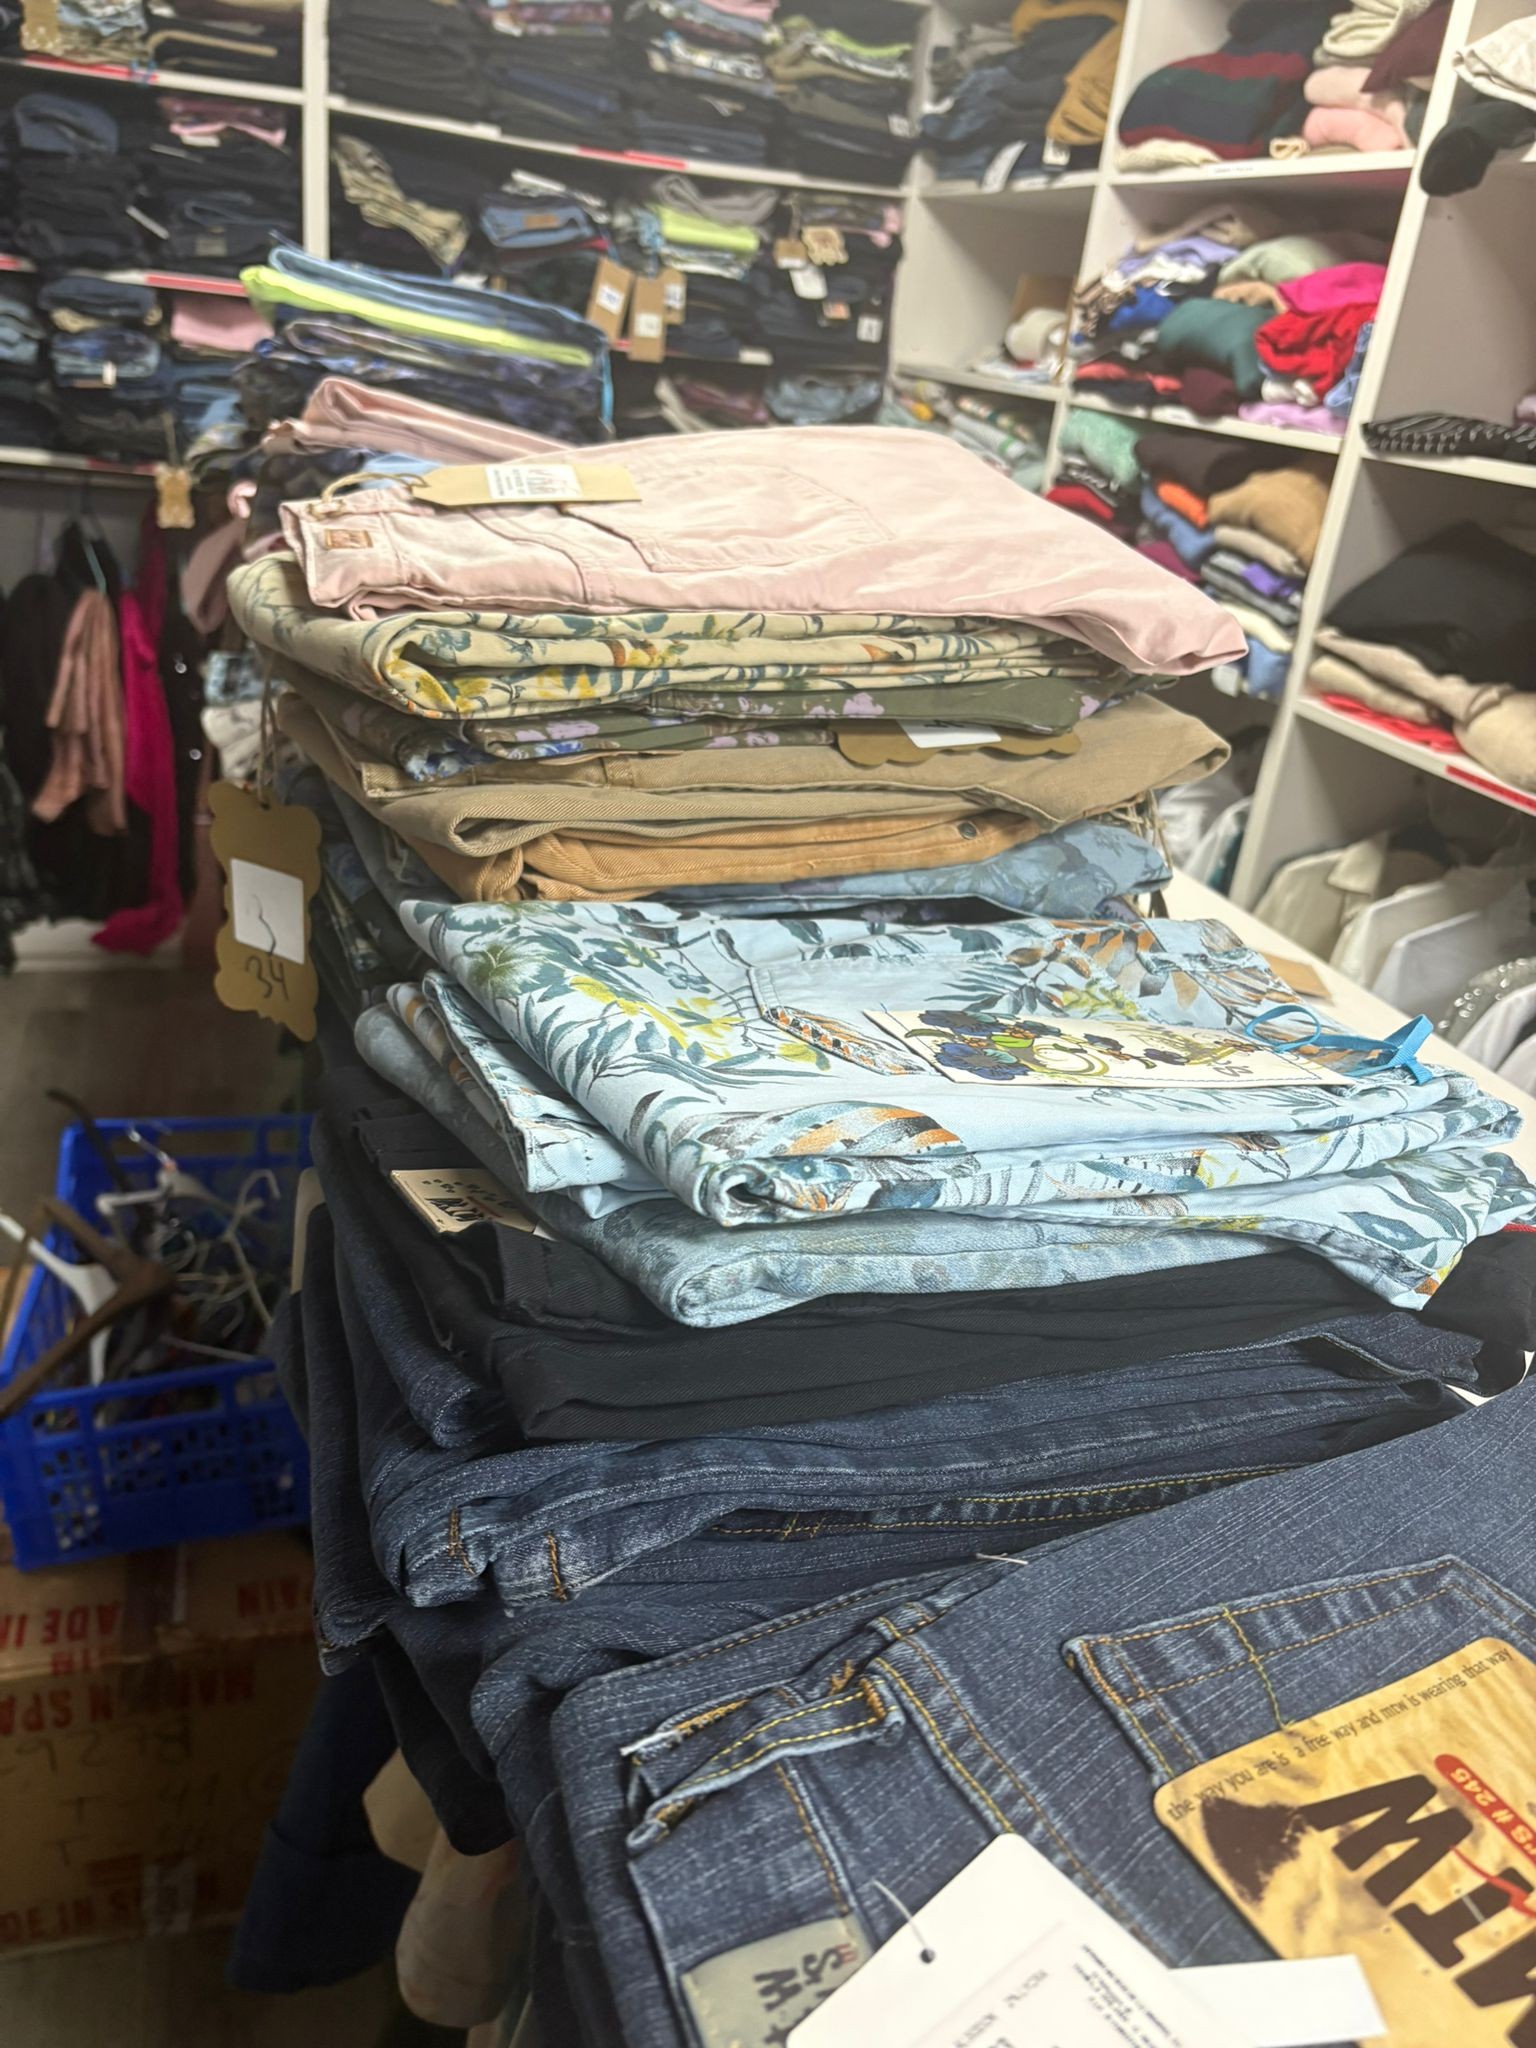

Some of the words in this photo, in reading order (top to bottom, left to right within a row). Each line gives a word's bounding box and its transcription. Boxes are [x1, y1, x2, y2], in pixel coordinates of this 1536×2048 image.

[42, 1601, 122, 1646] ADE
[1167, 1798, 1196, 1821] the
[1194, 1781, 1227, 1808] way
[1225, 1768, 1255, 1793] you
[1253, 1758, 1277, 1777] are
[1294, 1744, 1305, 1758] a
[1302, 1733, 1332, 1756] free
[1330, 1720, 1358, 1739] way
[1357, 1709, 1383, 1730] and
[1403, 1693, 1422, 1708] is
[1418, 1677, 1468, 1702] wearing
[1461, 1660, 1490, 1679] that
[1486, 1648, 1513, 1666] way
[1450, 1768, 1497, 1807] 245
